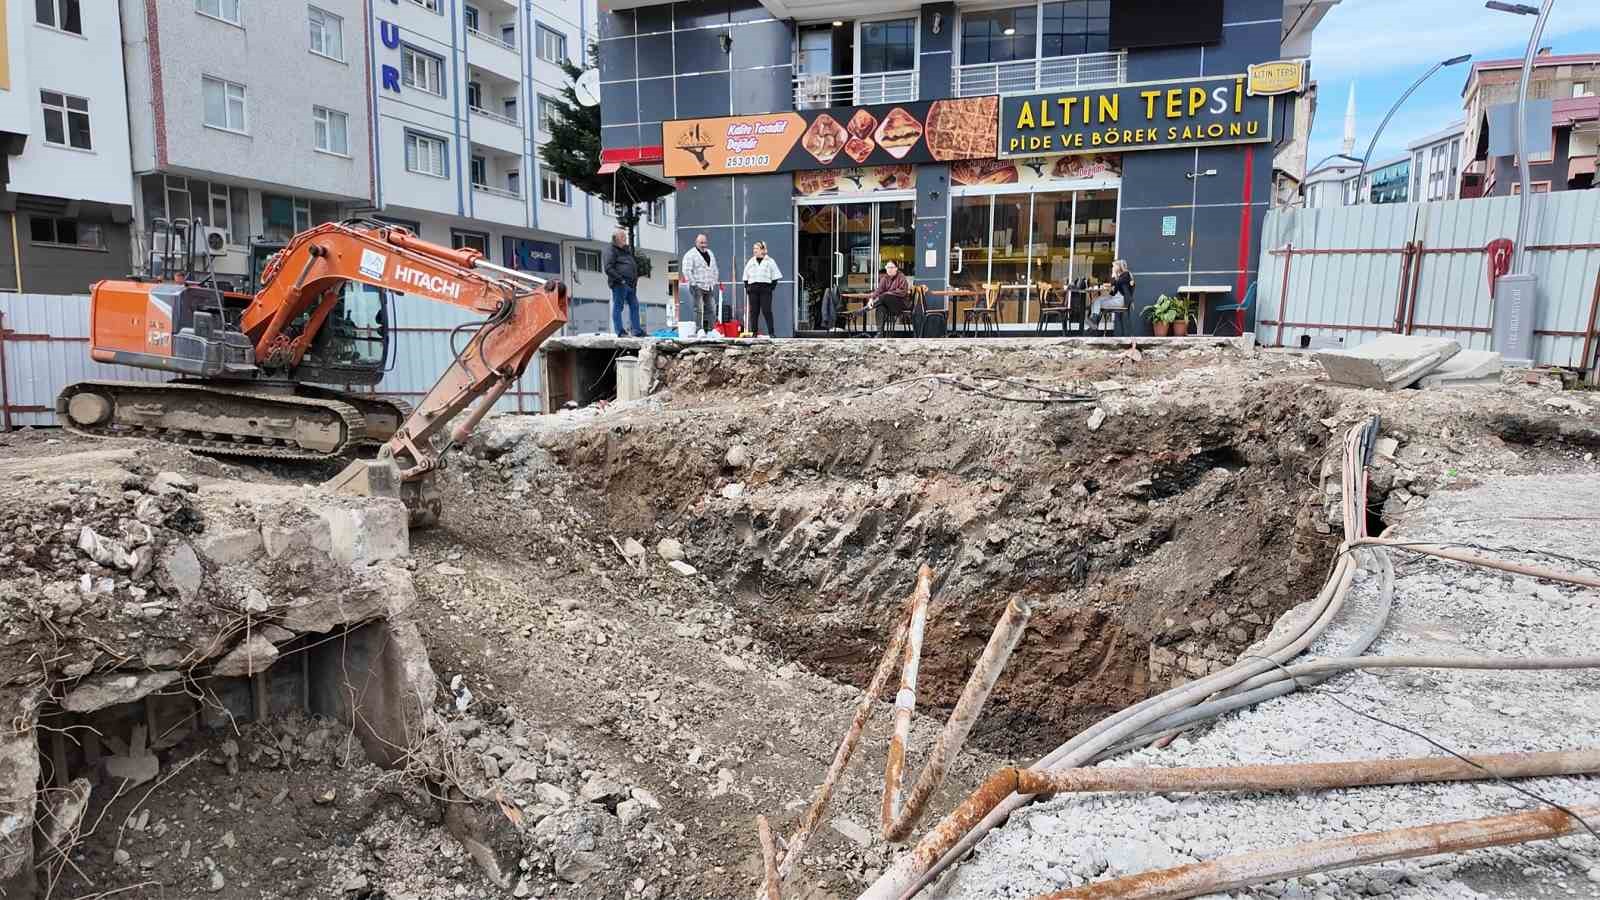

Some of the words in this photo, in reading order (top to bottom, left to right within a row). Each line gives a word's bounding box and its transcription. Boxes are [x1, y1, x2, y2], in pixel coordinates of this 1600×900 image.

[380, 0, 400, 93] UR
[1016, 93, 1119, 129] ALTIN
[1141, 78, 1244, 119] TEPSİ
[1010, 134, 1051, 151] PİDE
[1060, 133, 1083, 147] VE
[1092, 127, 1158, 145] BÖREK
[1167, 121, 1258, 140] SALONU
[394, 264, 461, 299] HITACHI
